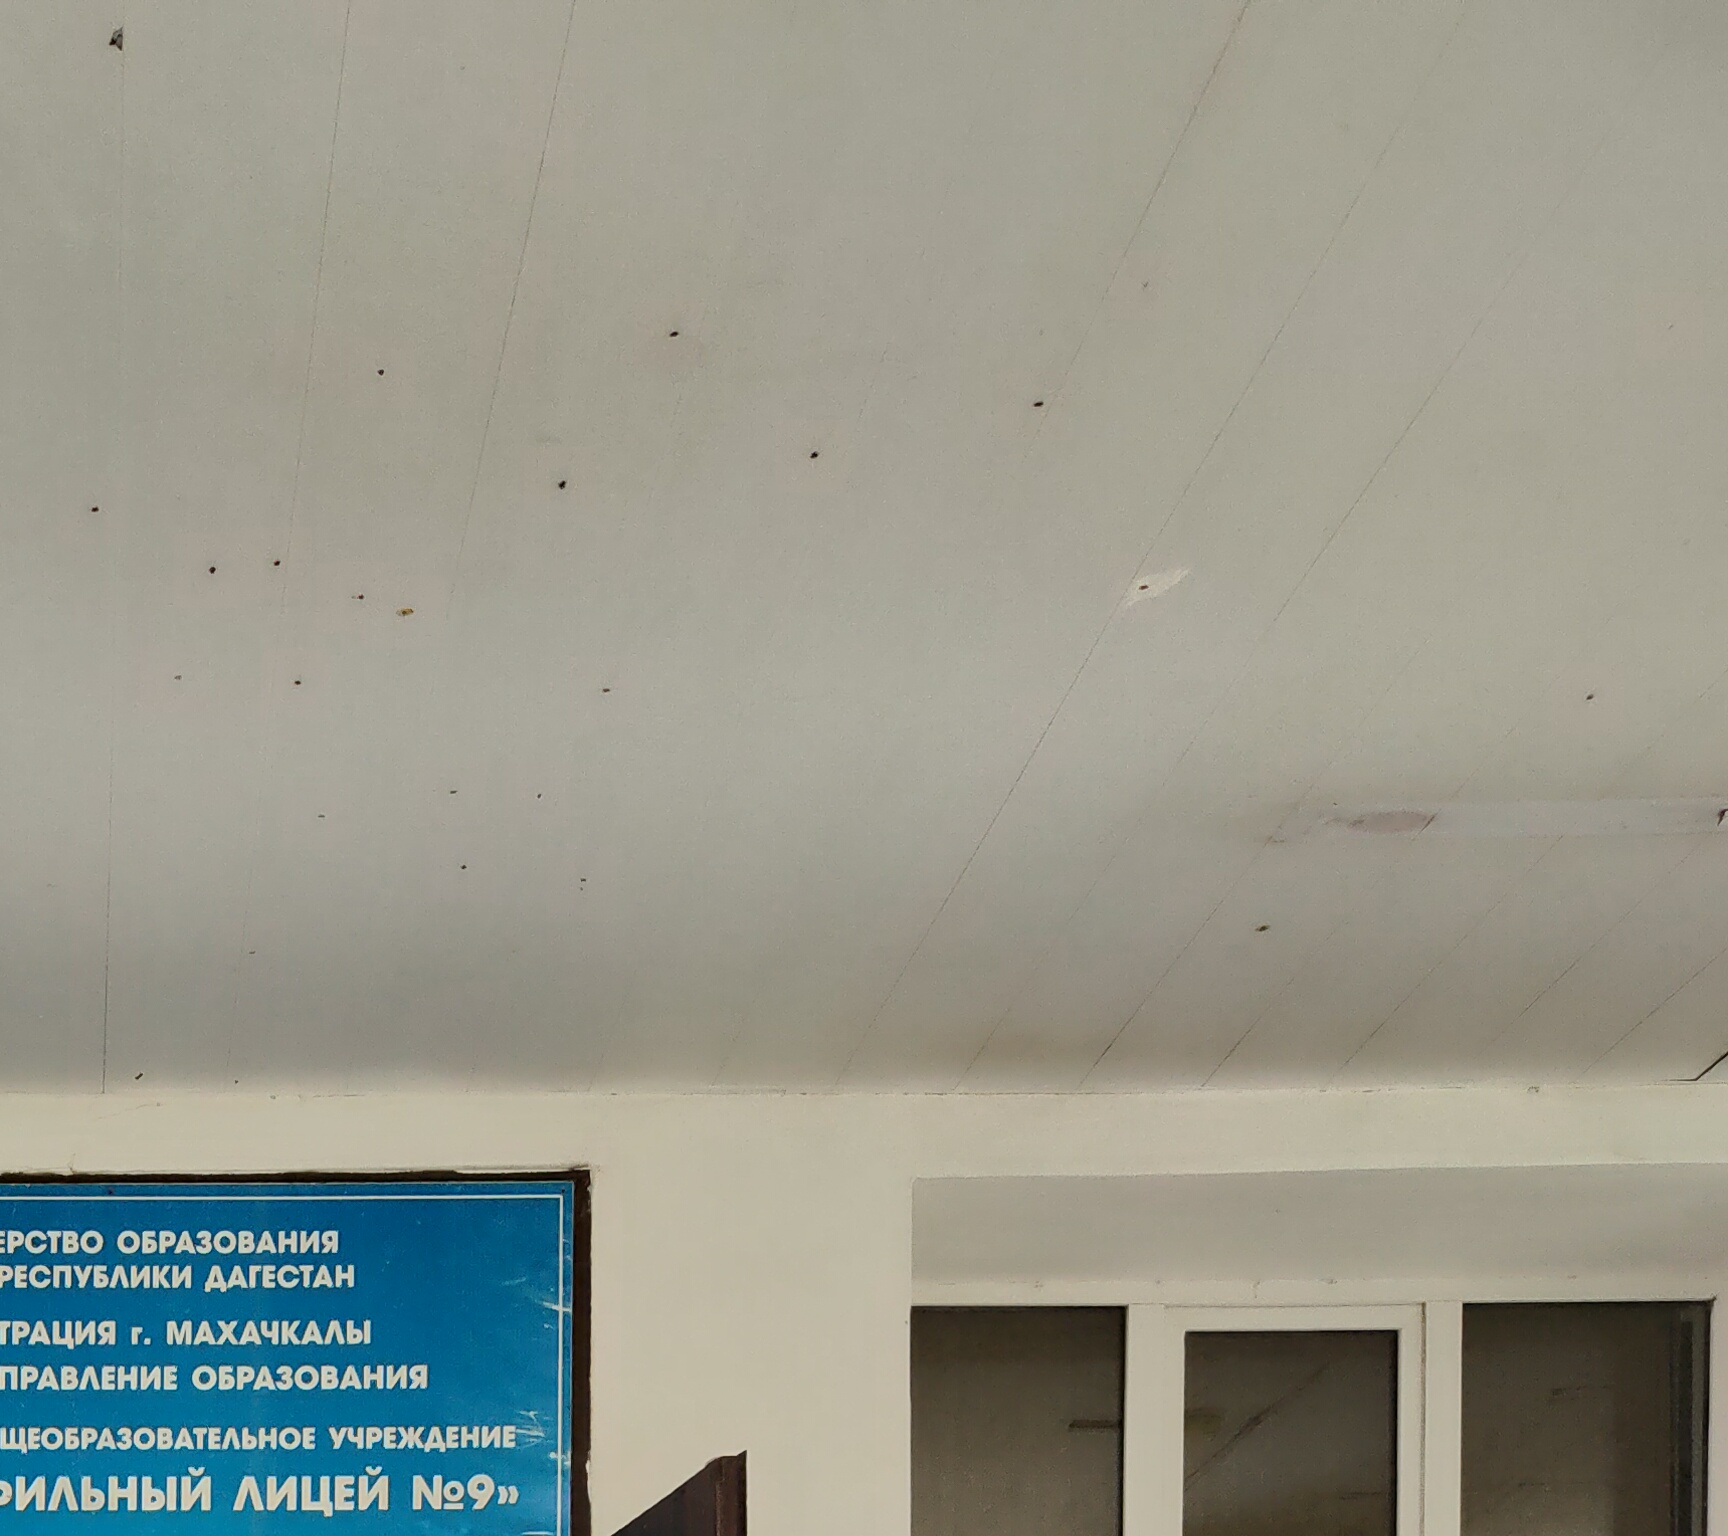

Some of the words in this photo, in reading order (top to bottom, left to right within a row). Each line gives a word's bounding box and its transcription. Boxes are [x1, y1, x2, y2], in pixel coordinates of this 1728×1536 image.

[116, 1230, 339, 1255] ОБРАЗОВАНИЯ
[204, 1264, 355, 1293] ДАГЕСТАН
[131, 1326, 152, 1346] г.
[166, 1319, 372, 1346] МАХАЧКАЛЫ
[191, 1364, 428, 1391] ОБРАЗОВАНИЯ
[328, 1425, 522, 1453] УЧРЕЖДЕНИЕ
[232, 1465, 389, 1518] ЛИЦЕЙ
[412, 1473, 520, 1511] №9»
